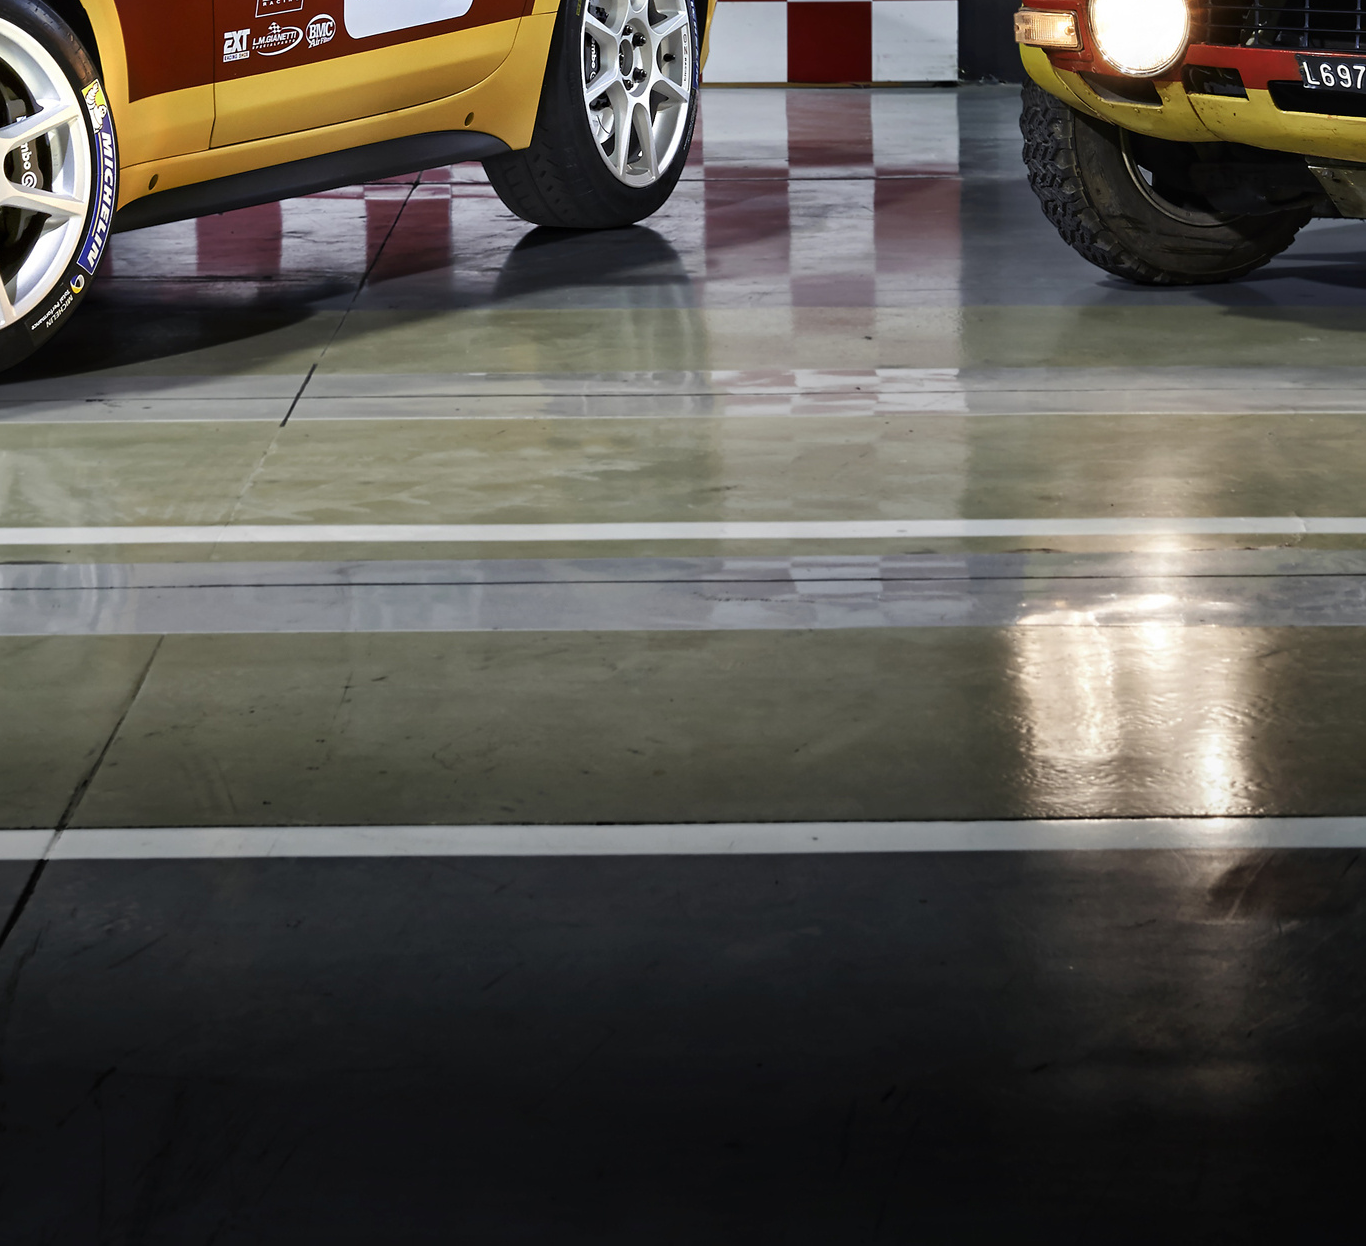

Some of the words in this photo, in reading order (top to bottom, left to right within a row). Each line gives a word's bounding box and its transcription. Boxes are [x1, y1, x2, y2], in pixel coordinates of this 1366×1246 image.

[309, 21, 334, 40] BMC
[86, 131, 114, 268] MICHELIN
[46, 294, 73, 328] MICHELIN
